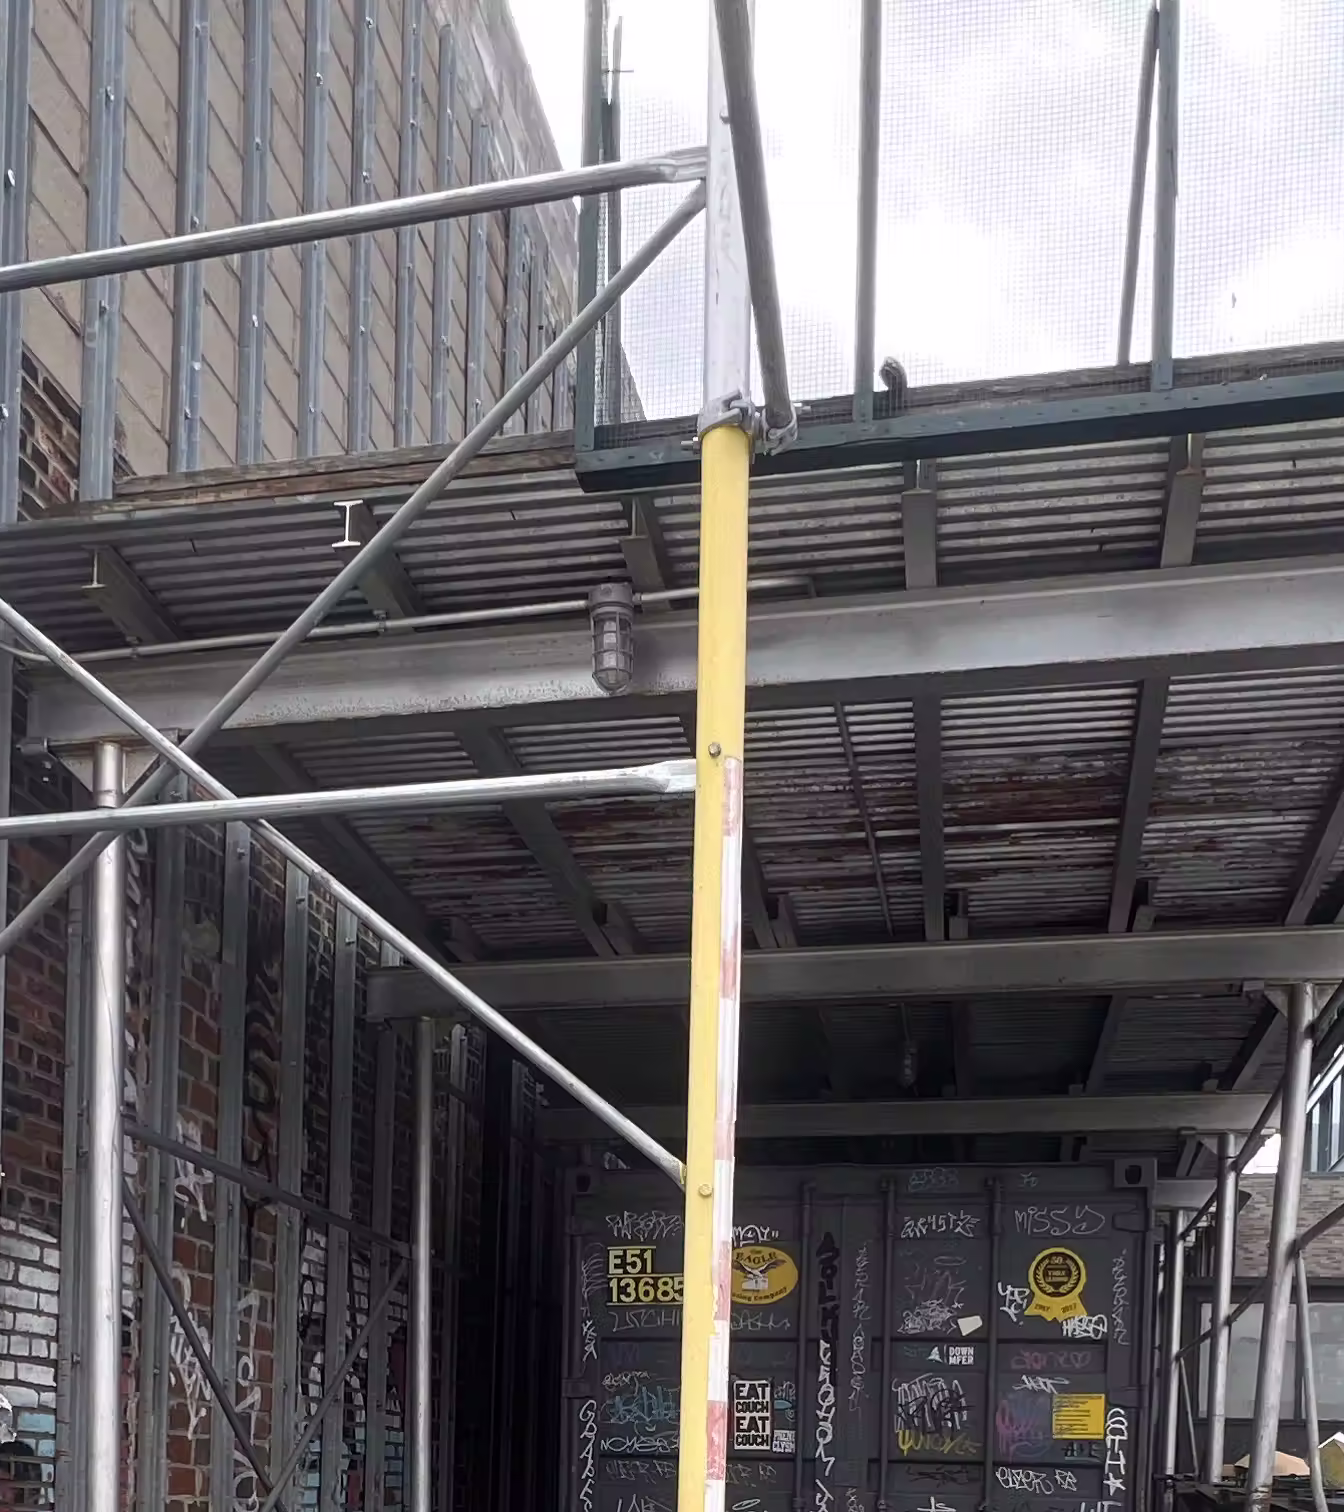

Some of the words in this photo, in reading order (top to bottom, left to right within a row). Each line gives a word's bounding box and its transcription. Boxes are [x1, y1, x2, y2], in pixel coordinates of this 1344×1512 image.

[608, 1249, 652, 1275] E51
[736, 1251, 778, 1265] EAGLE
[948, 1346, 974, 1356] DOWN
[948, 1355, 974, 1365] MFER
[735, 1383, 770, 1400] EAT
[735, 1401, 769, 1413] COUCH
[735, 1416, 770, 1433] EAT
[735, 1434, 769, 1447] COUCH
